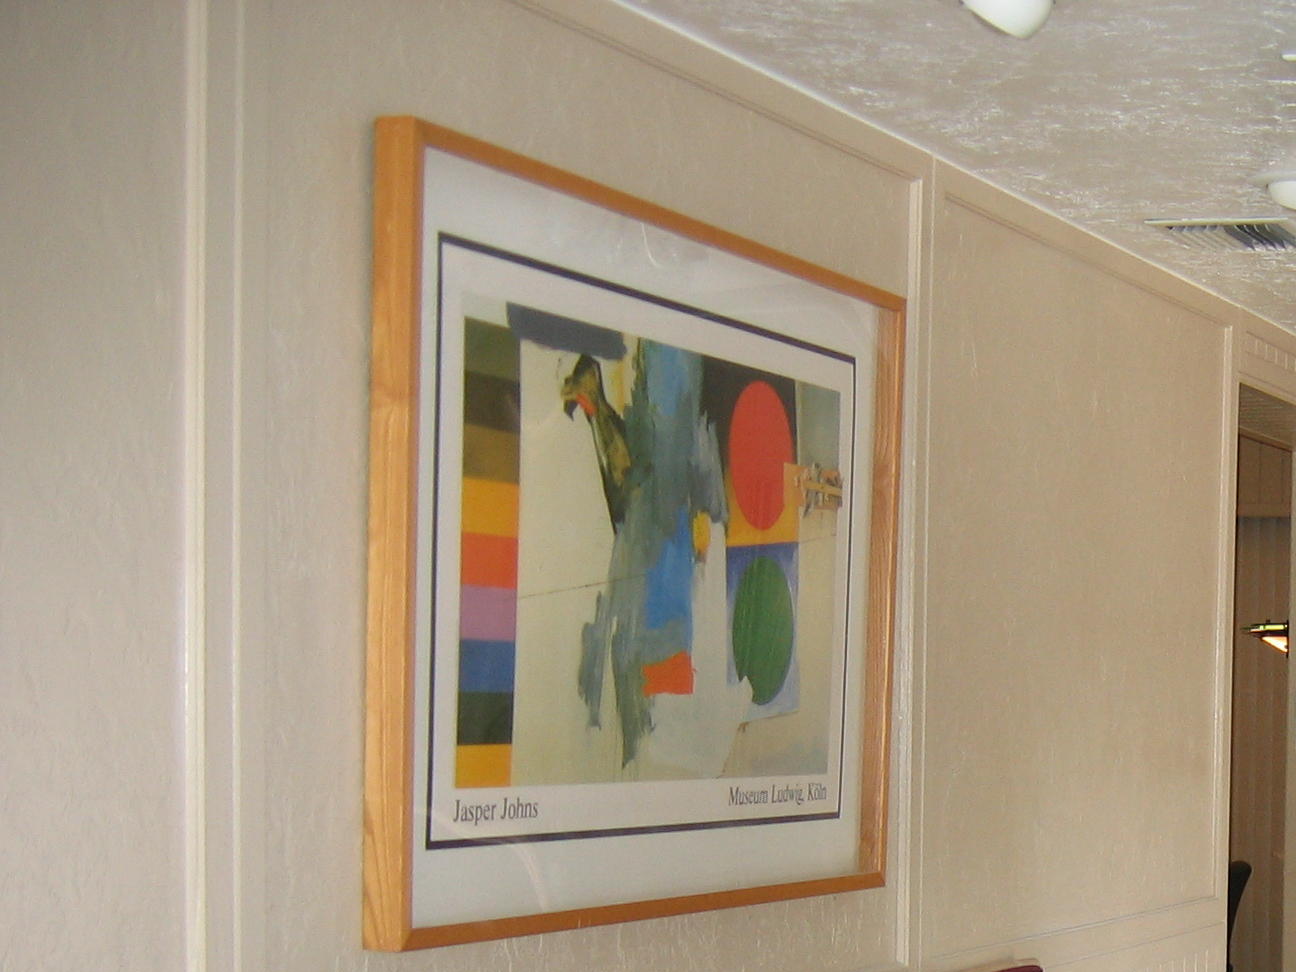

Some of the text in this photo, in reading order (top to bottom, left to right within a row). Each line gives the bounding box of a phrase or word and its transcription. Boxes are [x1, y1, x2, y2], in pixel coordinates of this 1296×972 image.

[728, 786, 769, 806] Museum
[807, 782, 827, 801] Köln
[453, 797, 539, 826] Jasper Johns
